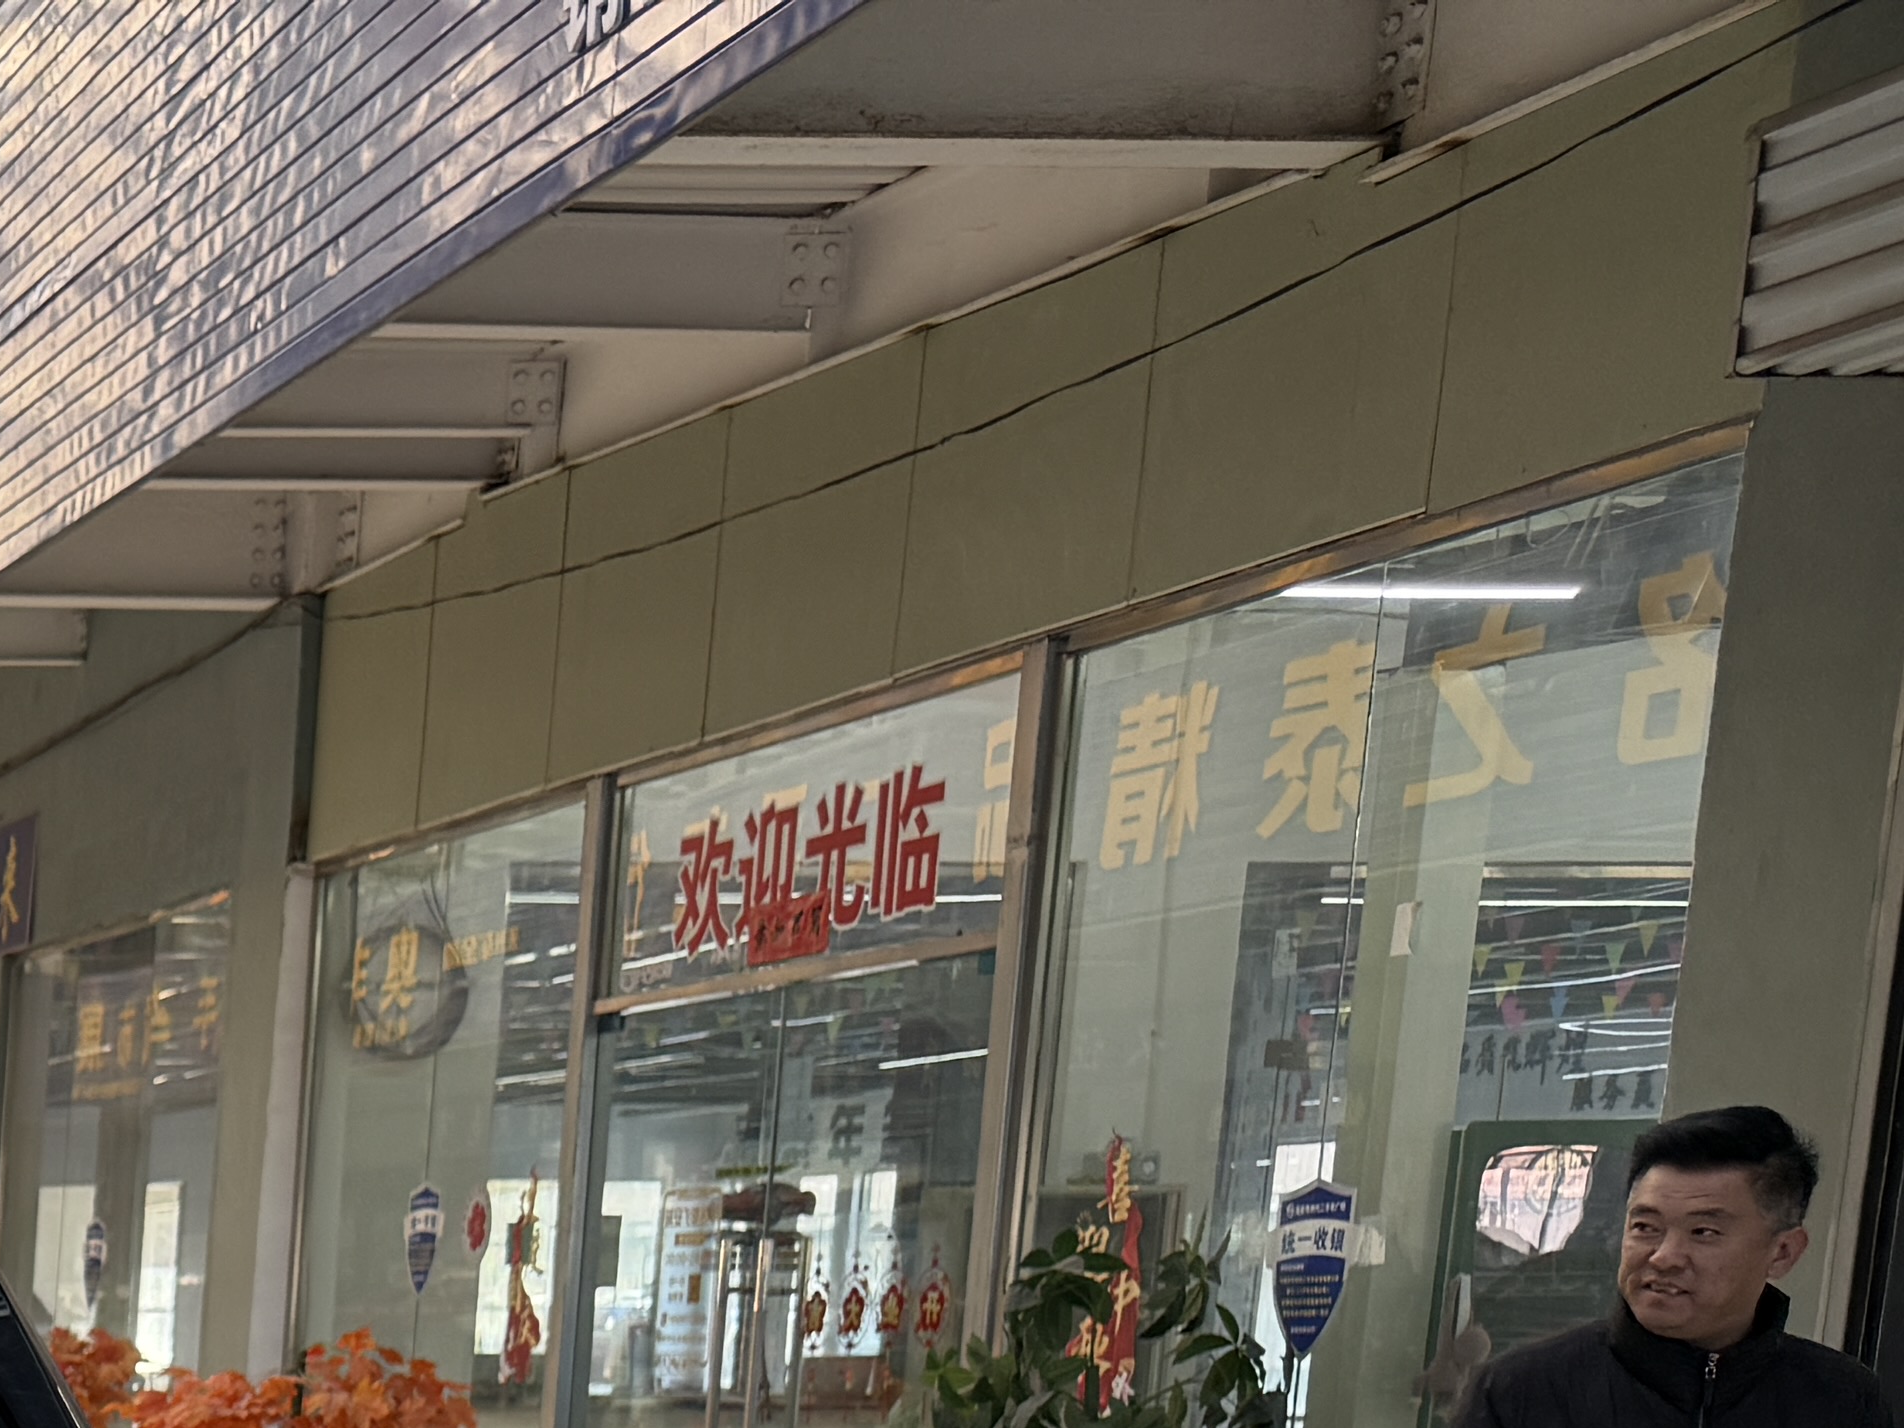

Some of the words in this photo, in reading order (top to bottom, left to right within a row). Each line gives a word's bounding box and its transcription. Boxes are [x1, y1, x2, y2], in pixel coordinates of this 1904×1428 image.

[673, 762, 947, 960] 欢迎光临
[1280, 1225, 1347, 1255] 统一收银
